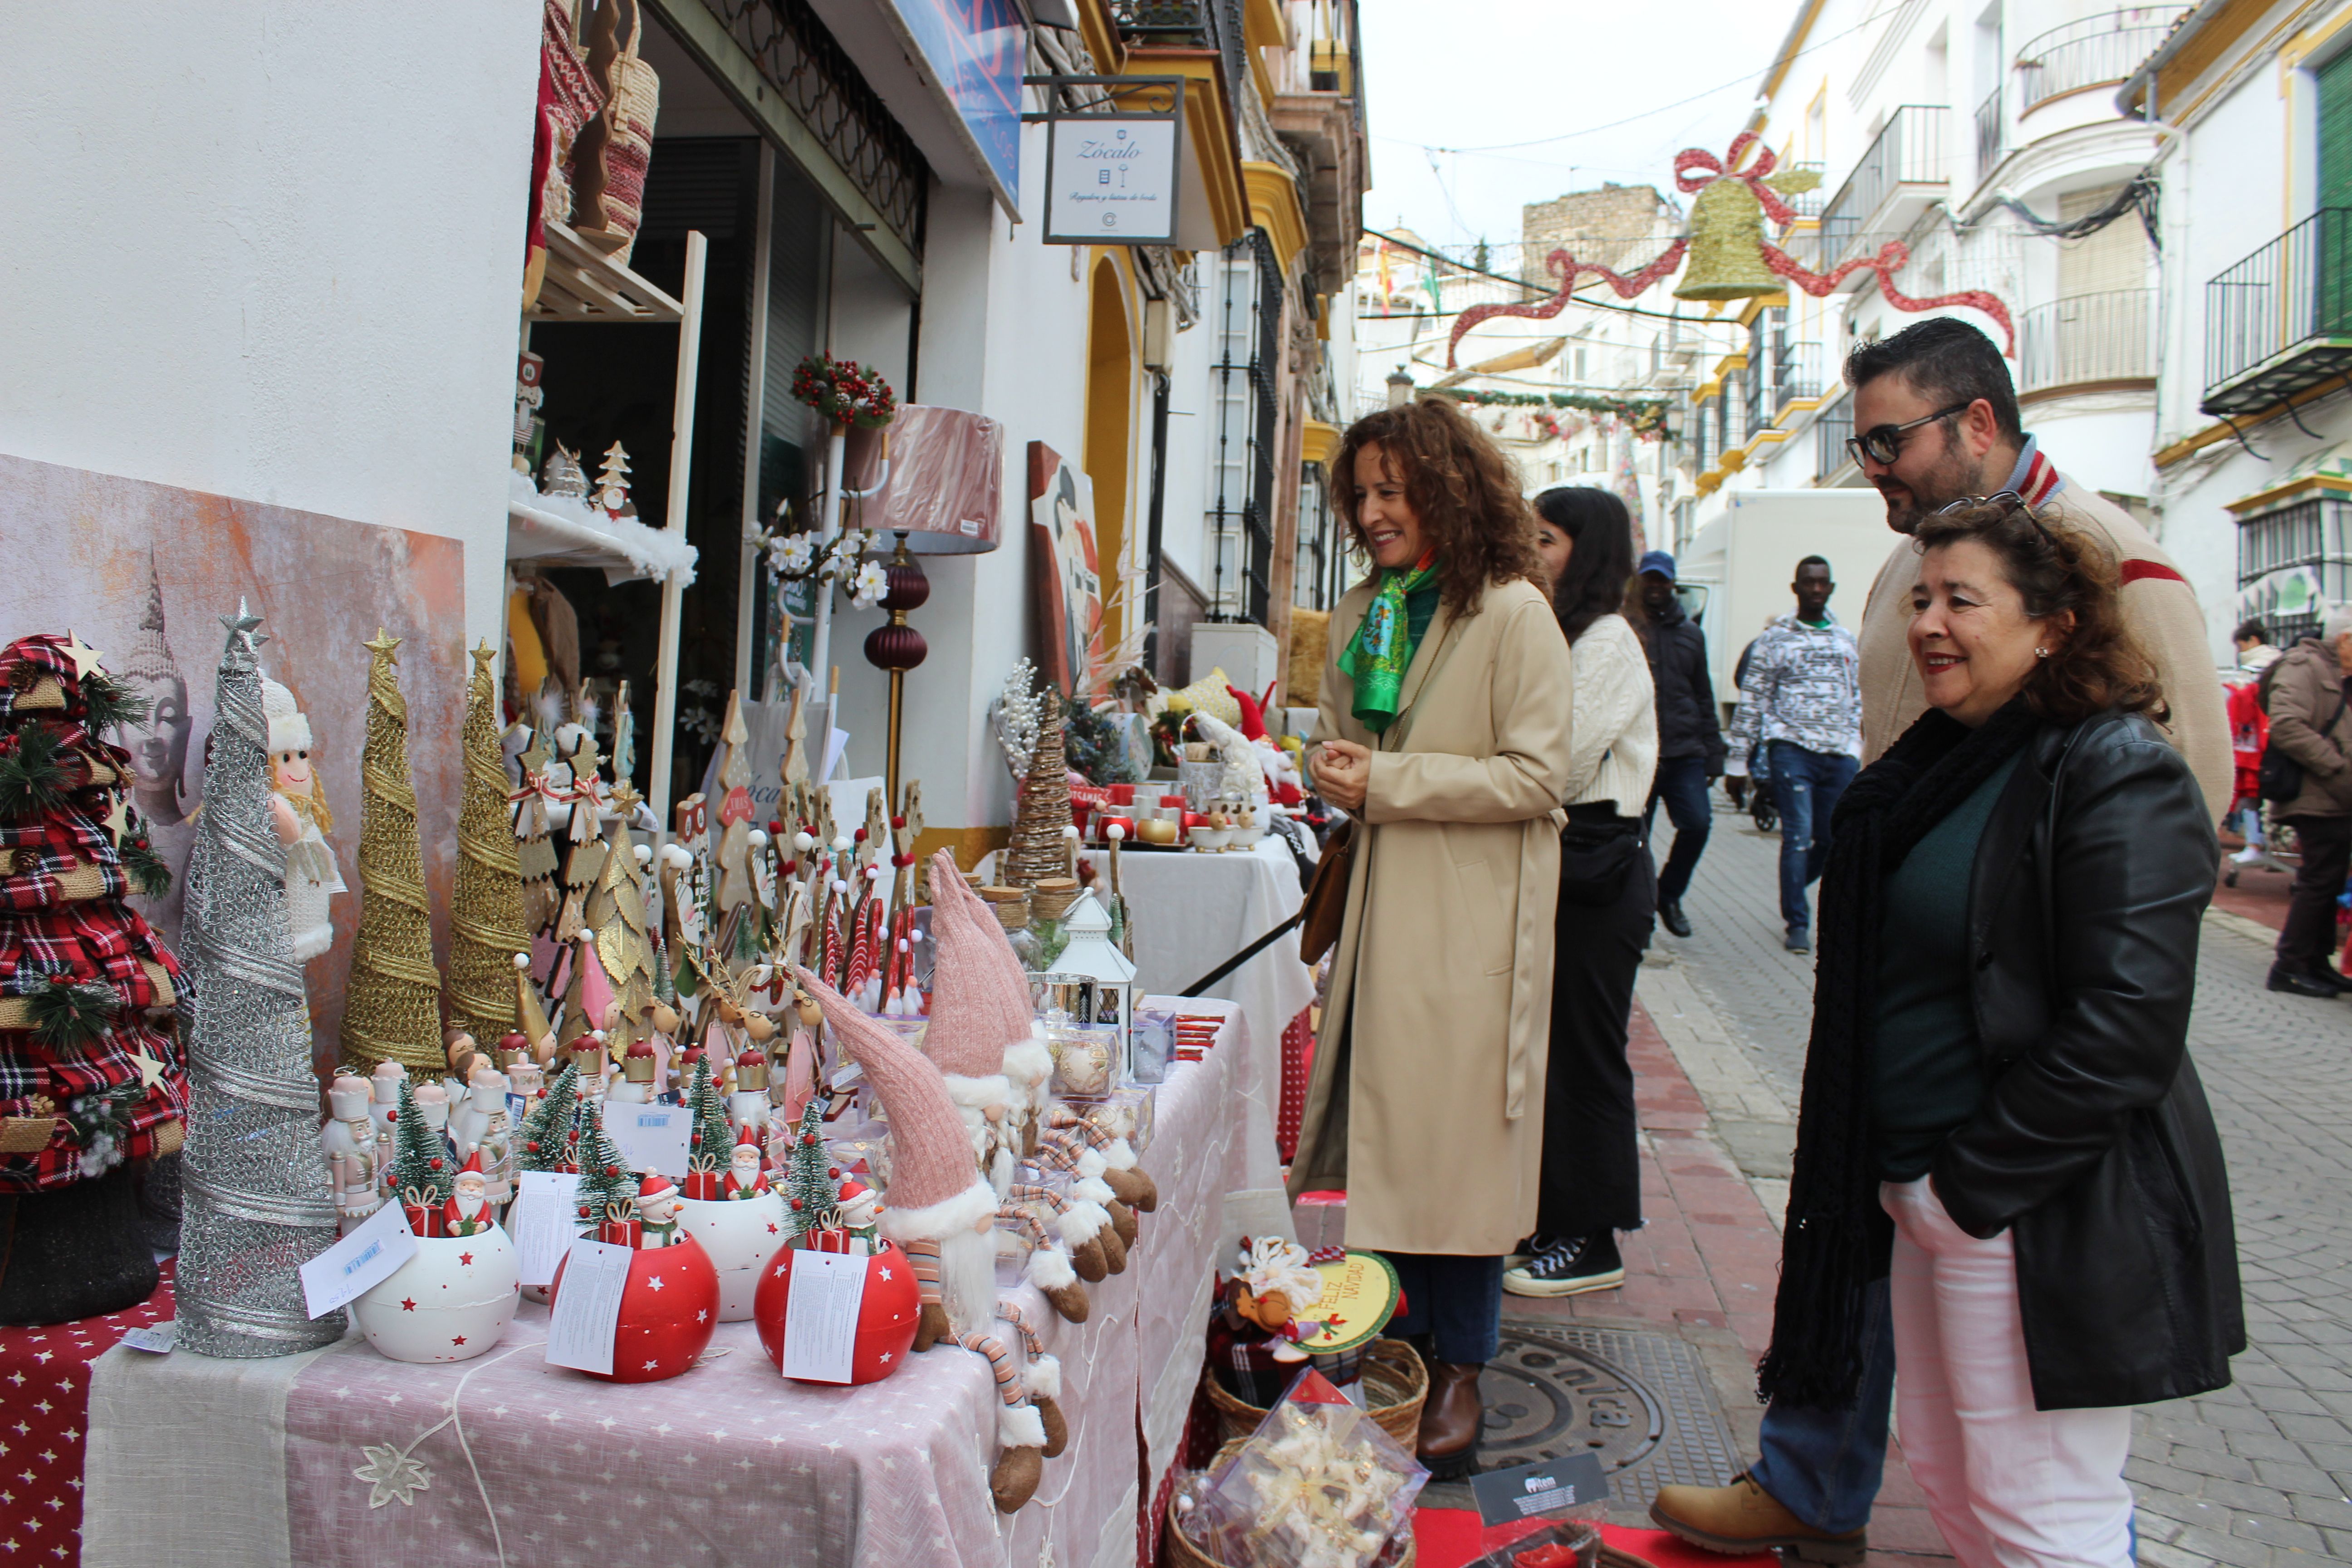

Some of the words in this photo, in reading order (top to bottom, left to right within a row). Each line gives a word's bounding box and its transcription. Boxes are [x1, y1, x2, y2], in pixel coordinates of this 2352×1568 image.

[1077, 140, 1142, 158] Zócalo
[1069, 191, 1099, 203] Regalos
[747, 774, 780, 803] óca
[730, 795, 749, 810] XMAS
[1342, 1263, 1364, 1299] NAVIDAD
[1318, 1281, 1343, 1310] FELIZ
